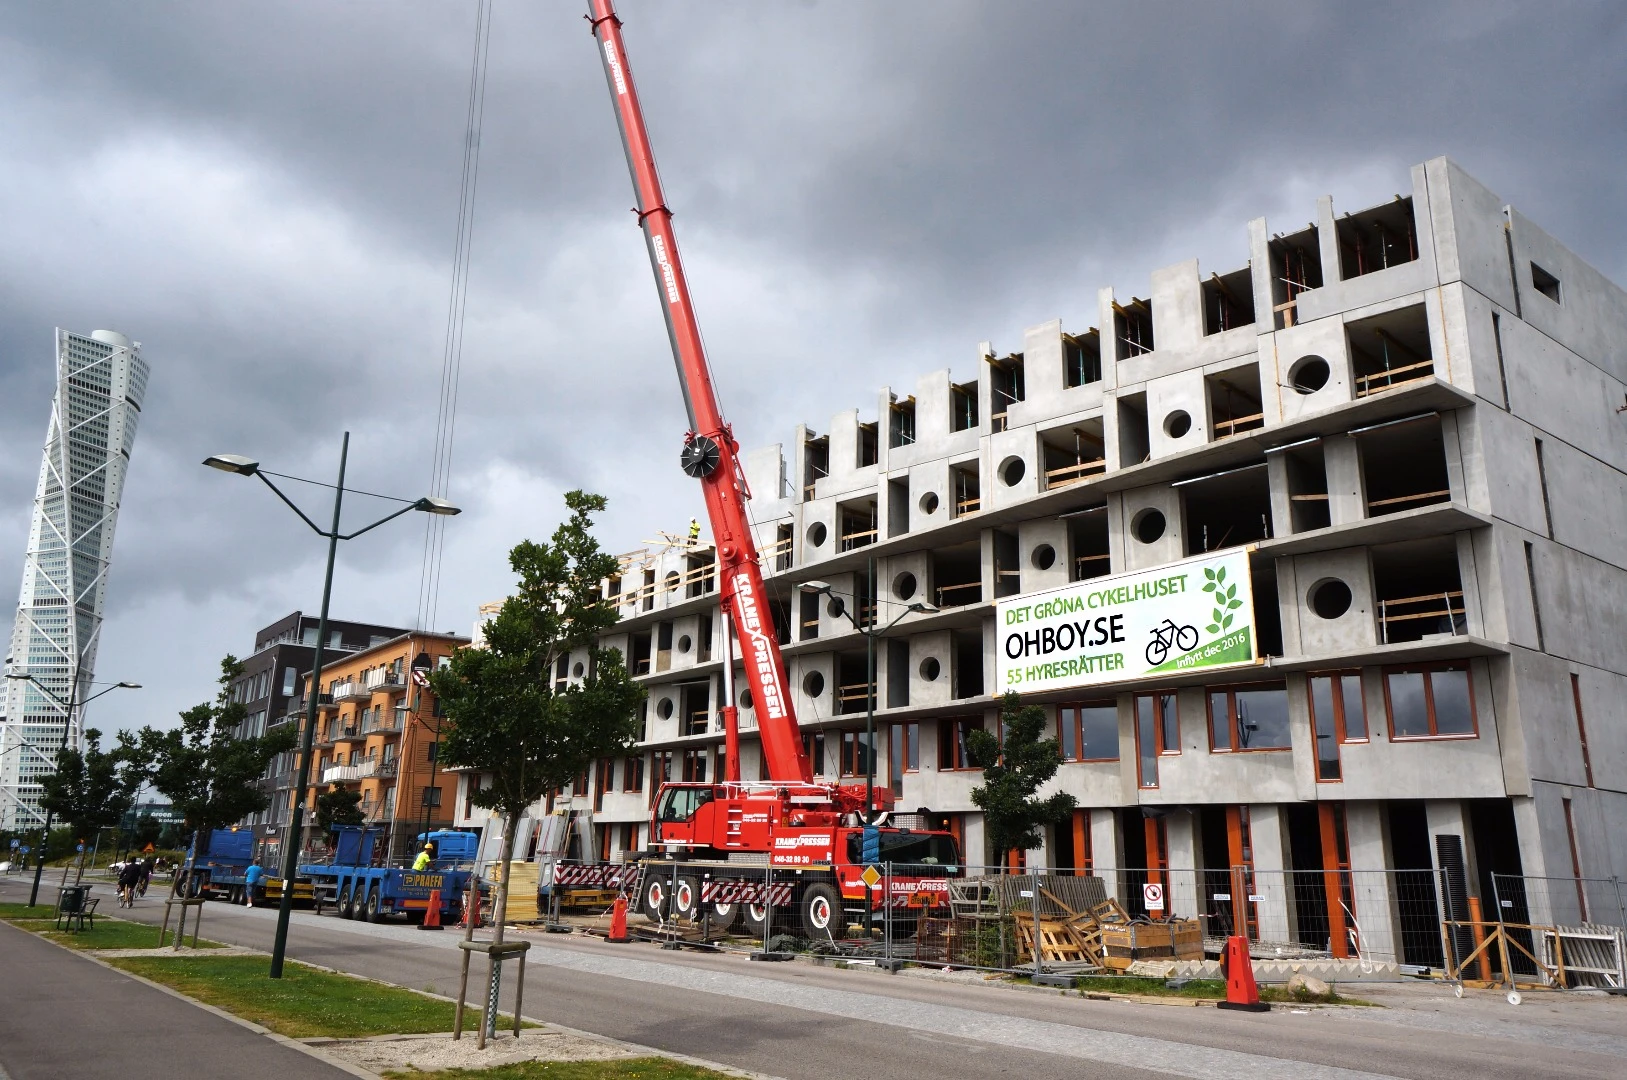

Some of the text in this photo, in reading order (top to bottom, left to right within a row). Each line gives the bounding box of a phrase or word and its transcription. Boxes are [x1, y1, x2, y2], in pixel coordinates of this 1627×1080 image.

[1006, 574, 1188, 625] DET GRÖNA CYKELHUSET
[736, 572, 782, 719] KRANEXPRESSEN
[1005, 613, 1126, 660] OHBOY.SE
[1204, 645, 1221, 658] dec
[1222, 633, 1246, 651] 2016
[1007, 652, 1125, 685] 55 HYRESRÄTTER
[775, 837, 831, 847] KRANEXPRESSEN
[415, 874, 443, 888] PRAEFA
